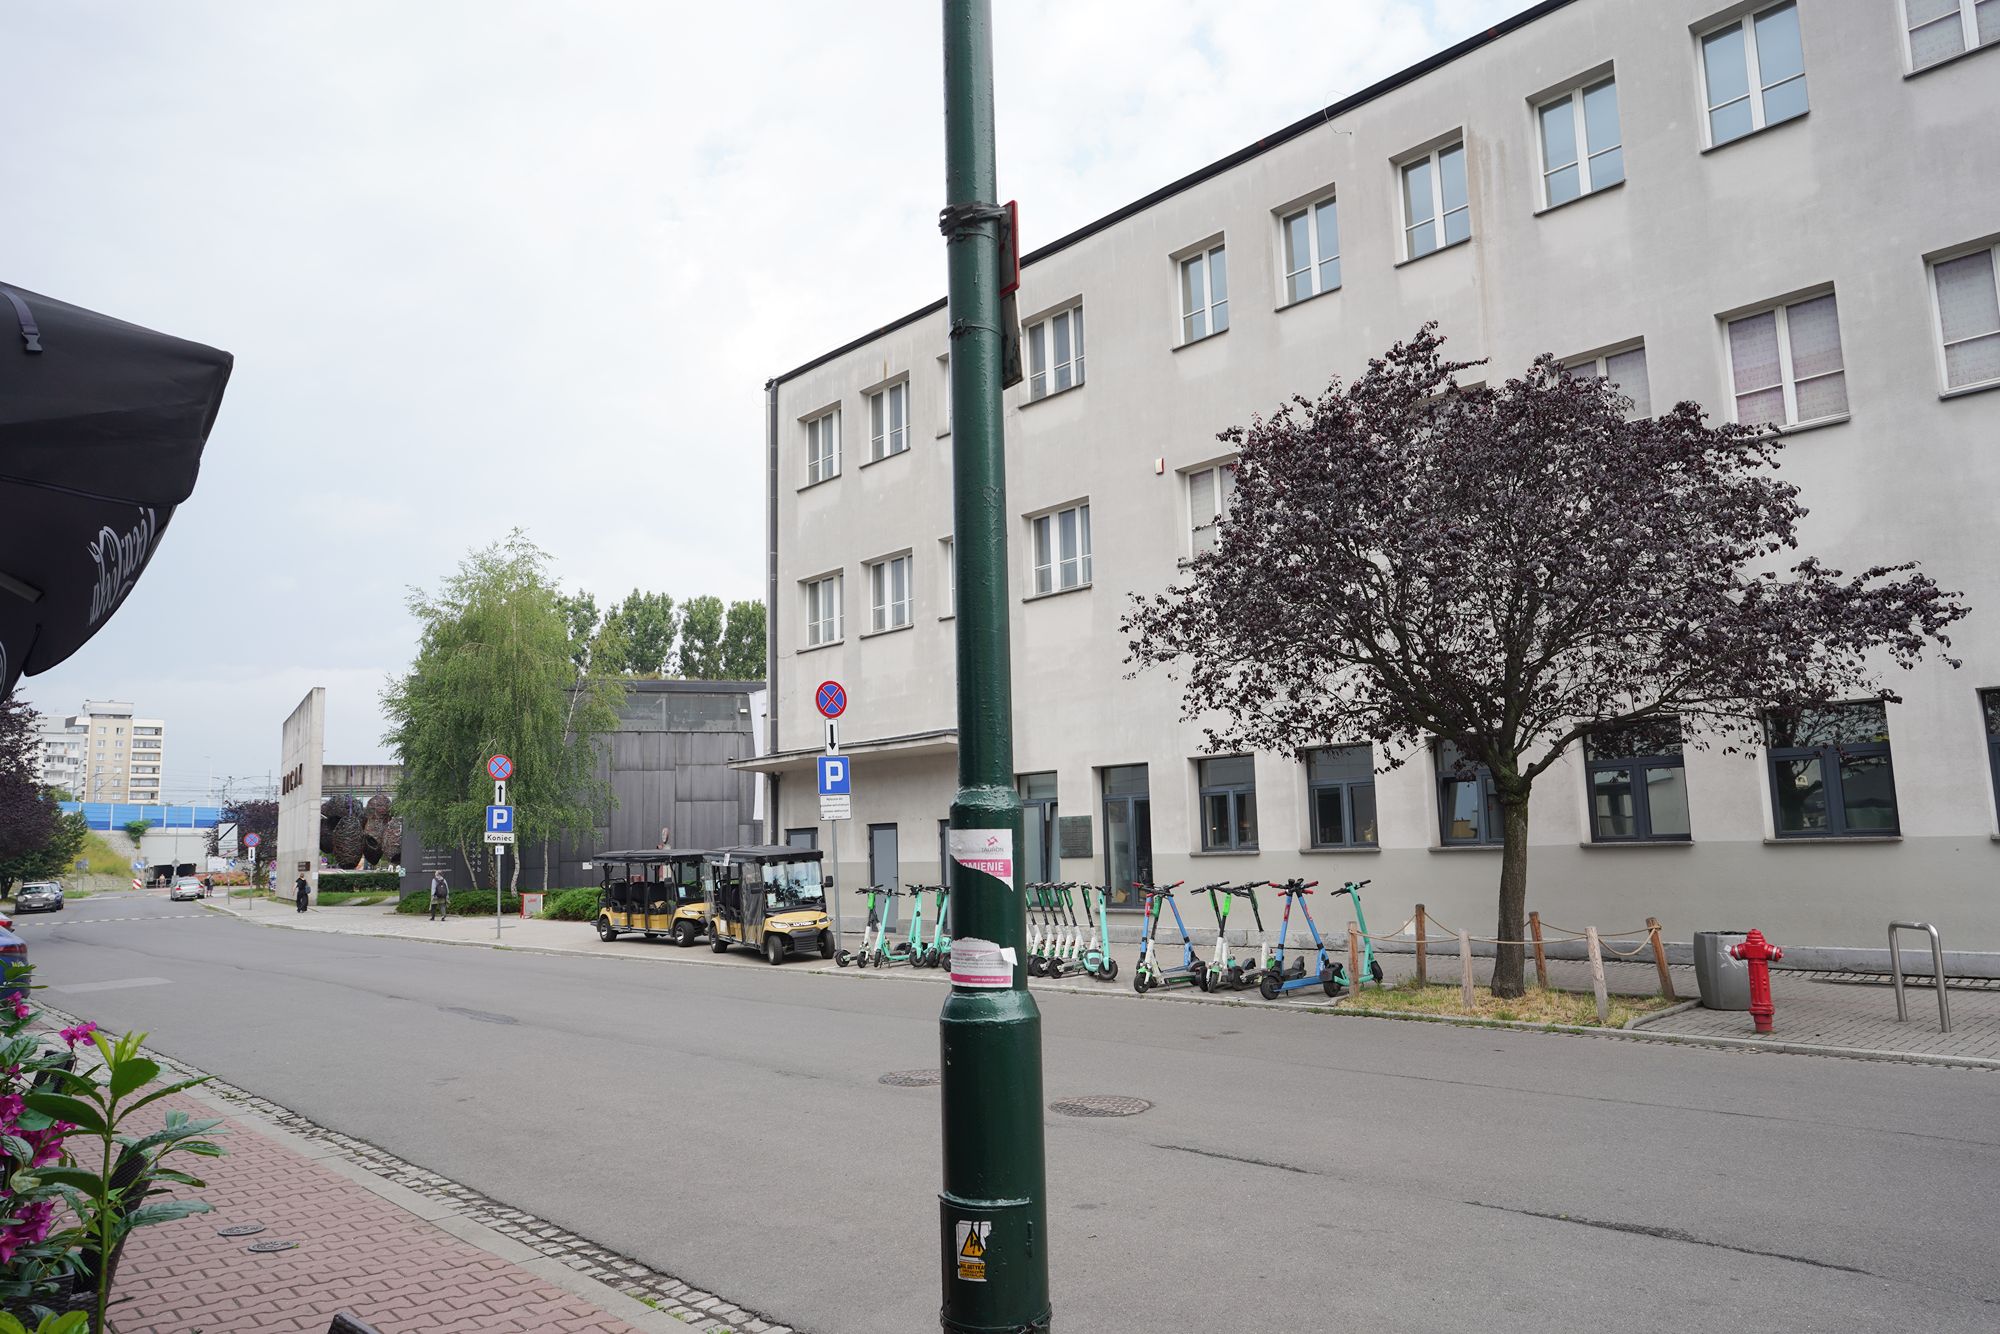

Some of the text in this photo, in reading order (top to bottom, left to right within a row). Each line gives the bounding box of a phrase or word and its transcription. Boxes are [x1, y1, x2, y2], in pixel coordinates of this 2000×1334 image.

[825, 760, 843, 790] P
[492, 808, 508, 829] P
[486, 833, 512, 841] Koniec
[960, 862, 1004, 872] OMIENIE
